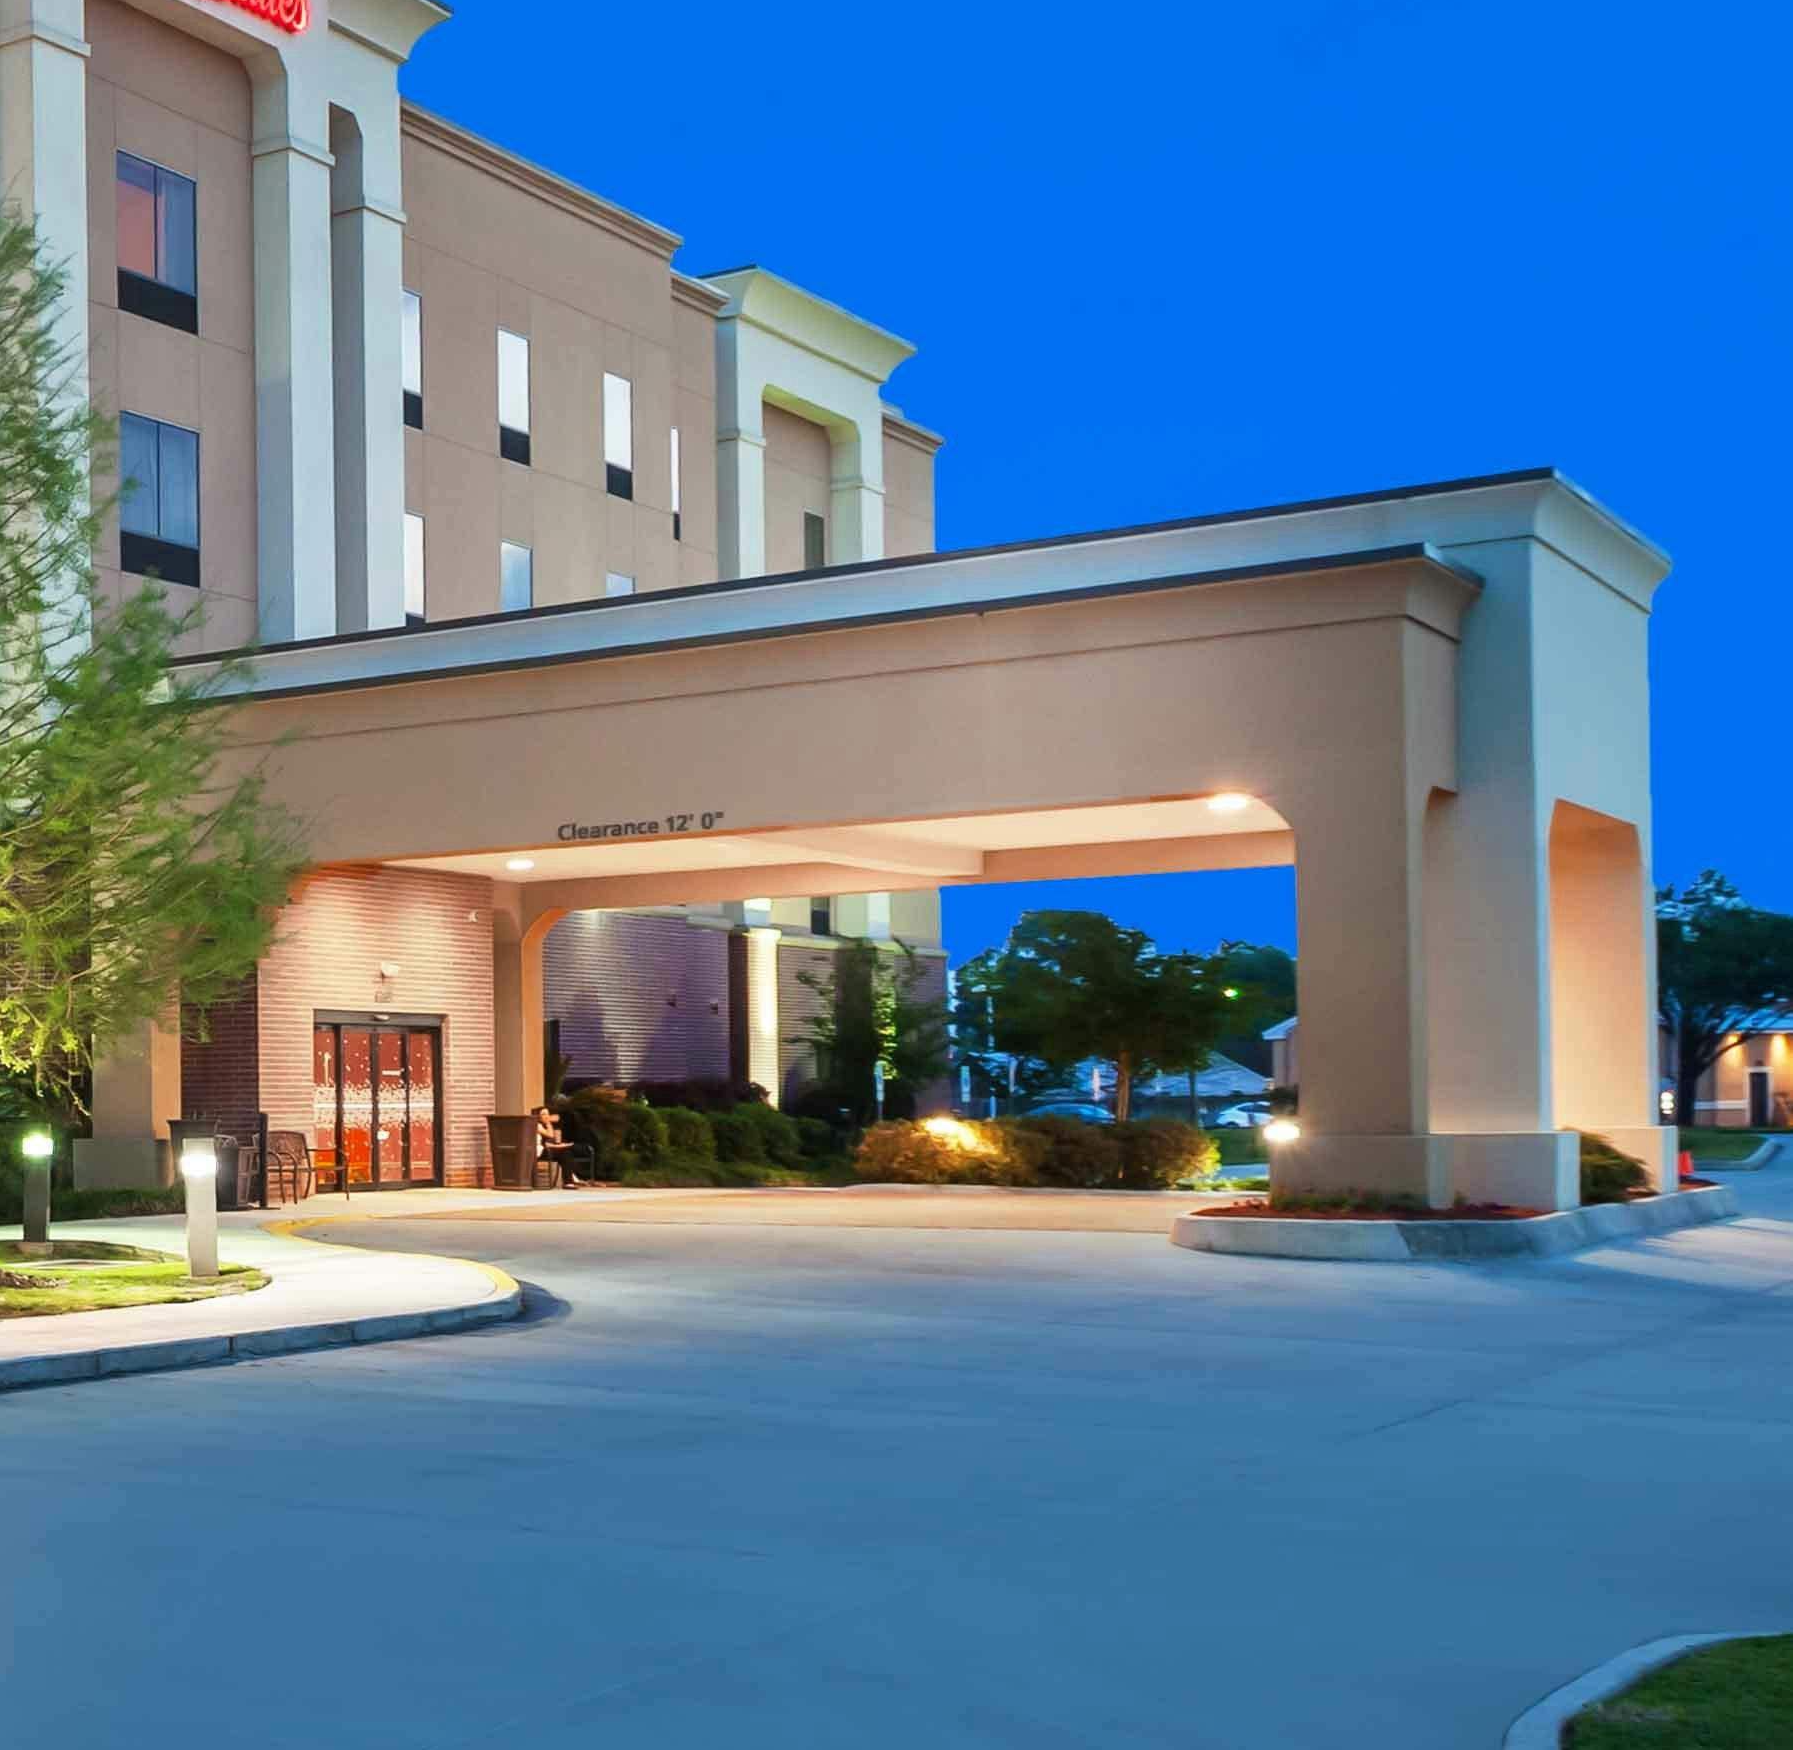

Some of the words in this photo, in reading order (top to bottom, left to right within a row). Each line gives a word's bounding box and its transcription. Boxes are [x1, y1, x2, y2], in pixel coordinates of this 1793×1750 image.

[557, 821, 659, 841] Clearance
[666, 813, 694, 832] 12'
[701, 811, 724, 830] 0"
